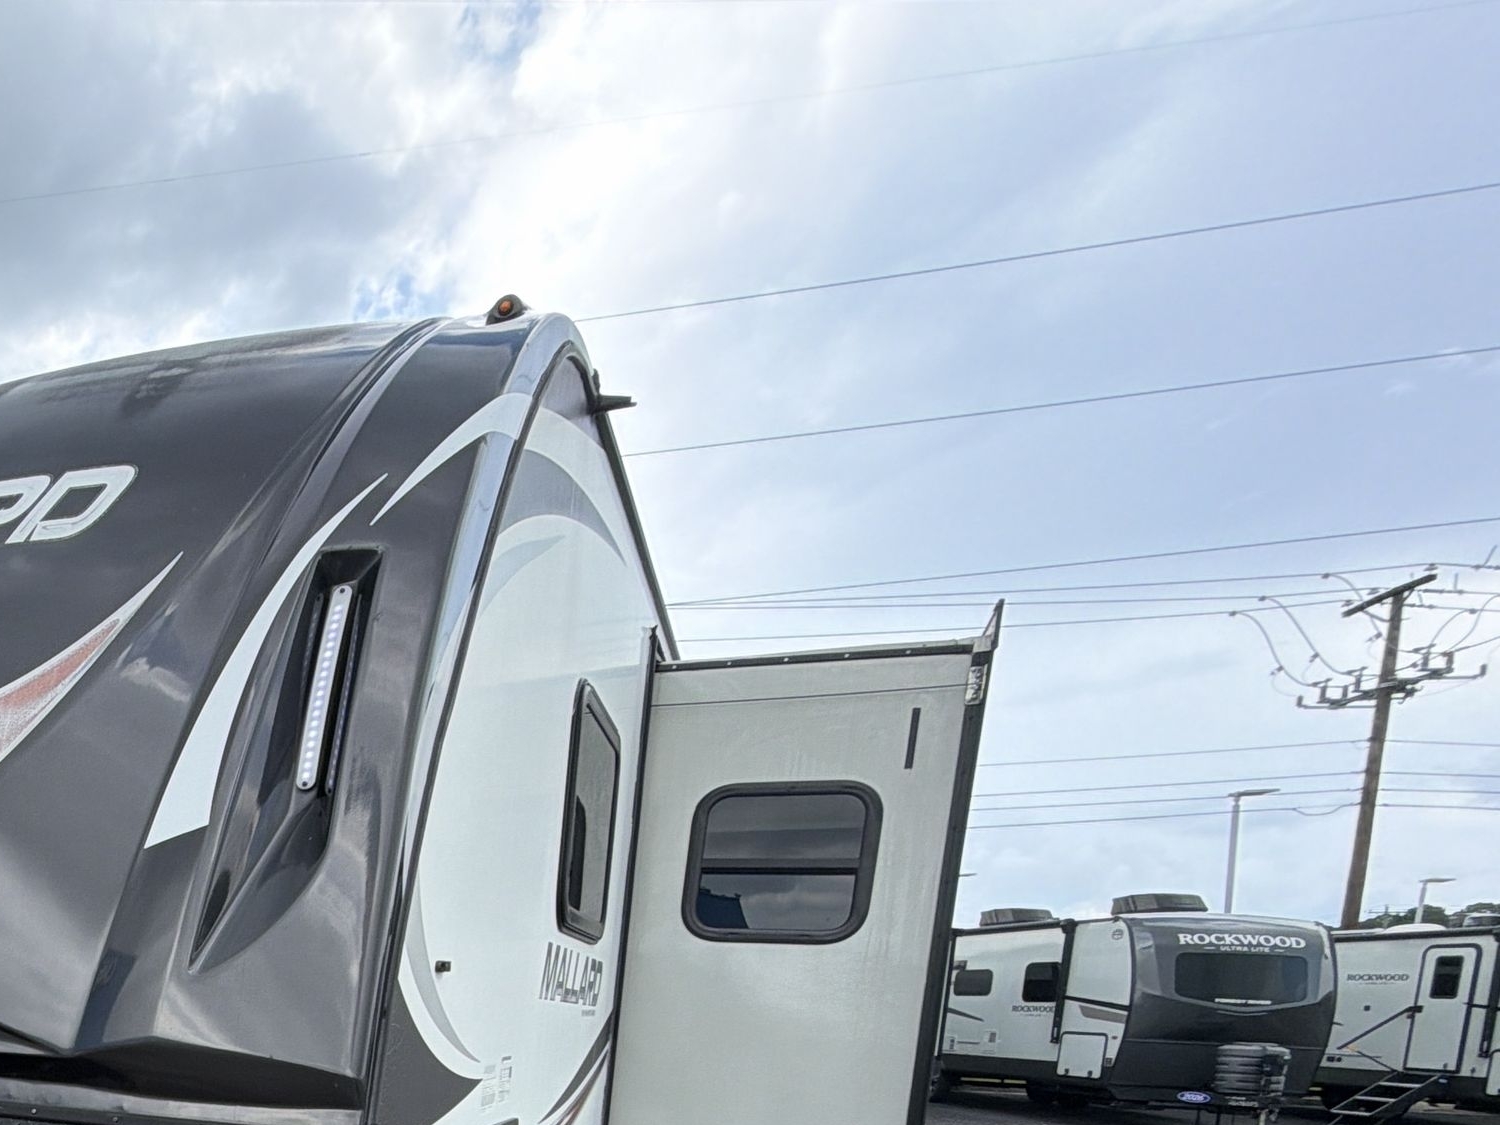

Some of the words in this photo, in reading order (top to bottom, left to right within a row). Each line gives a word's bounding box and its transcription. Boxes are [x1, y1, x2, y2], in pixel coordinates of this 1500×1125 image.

[1177, 933, 1306, 949] ROCKWOOD
[539, 941, 603, 1007] MALLARD
[1346, 973, 1410, 982] ROCKWOOD
